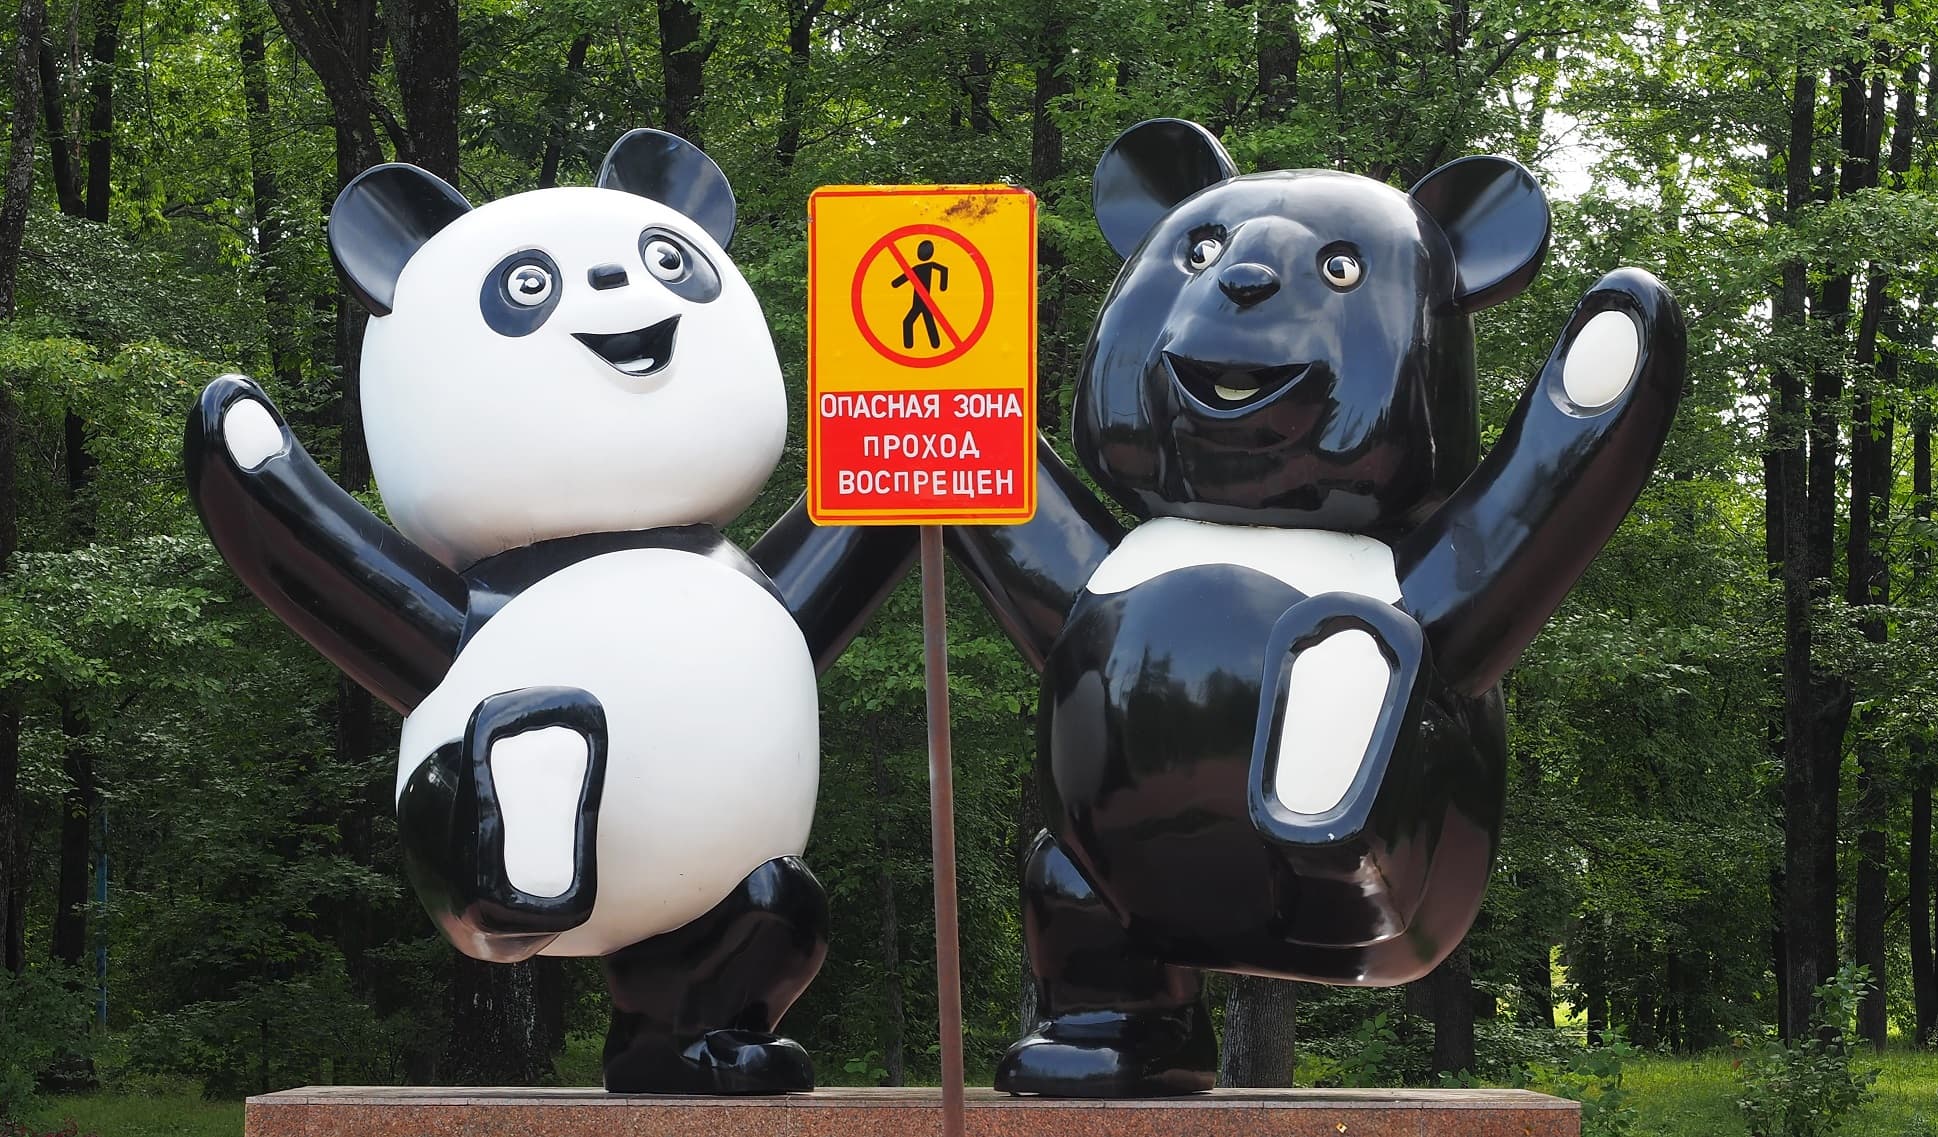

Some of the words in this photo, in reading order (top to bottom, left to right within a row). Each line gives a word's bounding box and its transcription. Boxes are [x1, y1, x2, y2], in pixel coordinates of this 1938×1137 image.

[820, 393, 940, 419] ОПАСНАЯ
[953, 393, 1023, 418] ЗОНА
[863, 431, 980, 459] ПРОХОД
[839, 470, 1013, 498] ВОСПРЕЩЕН
